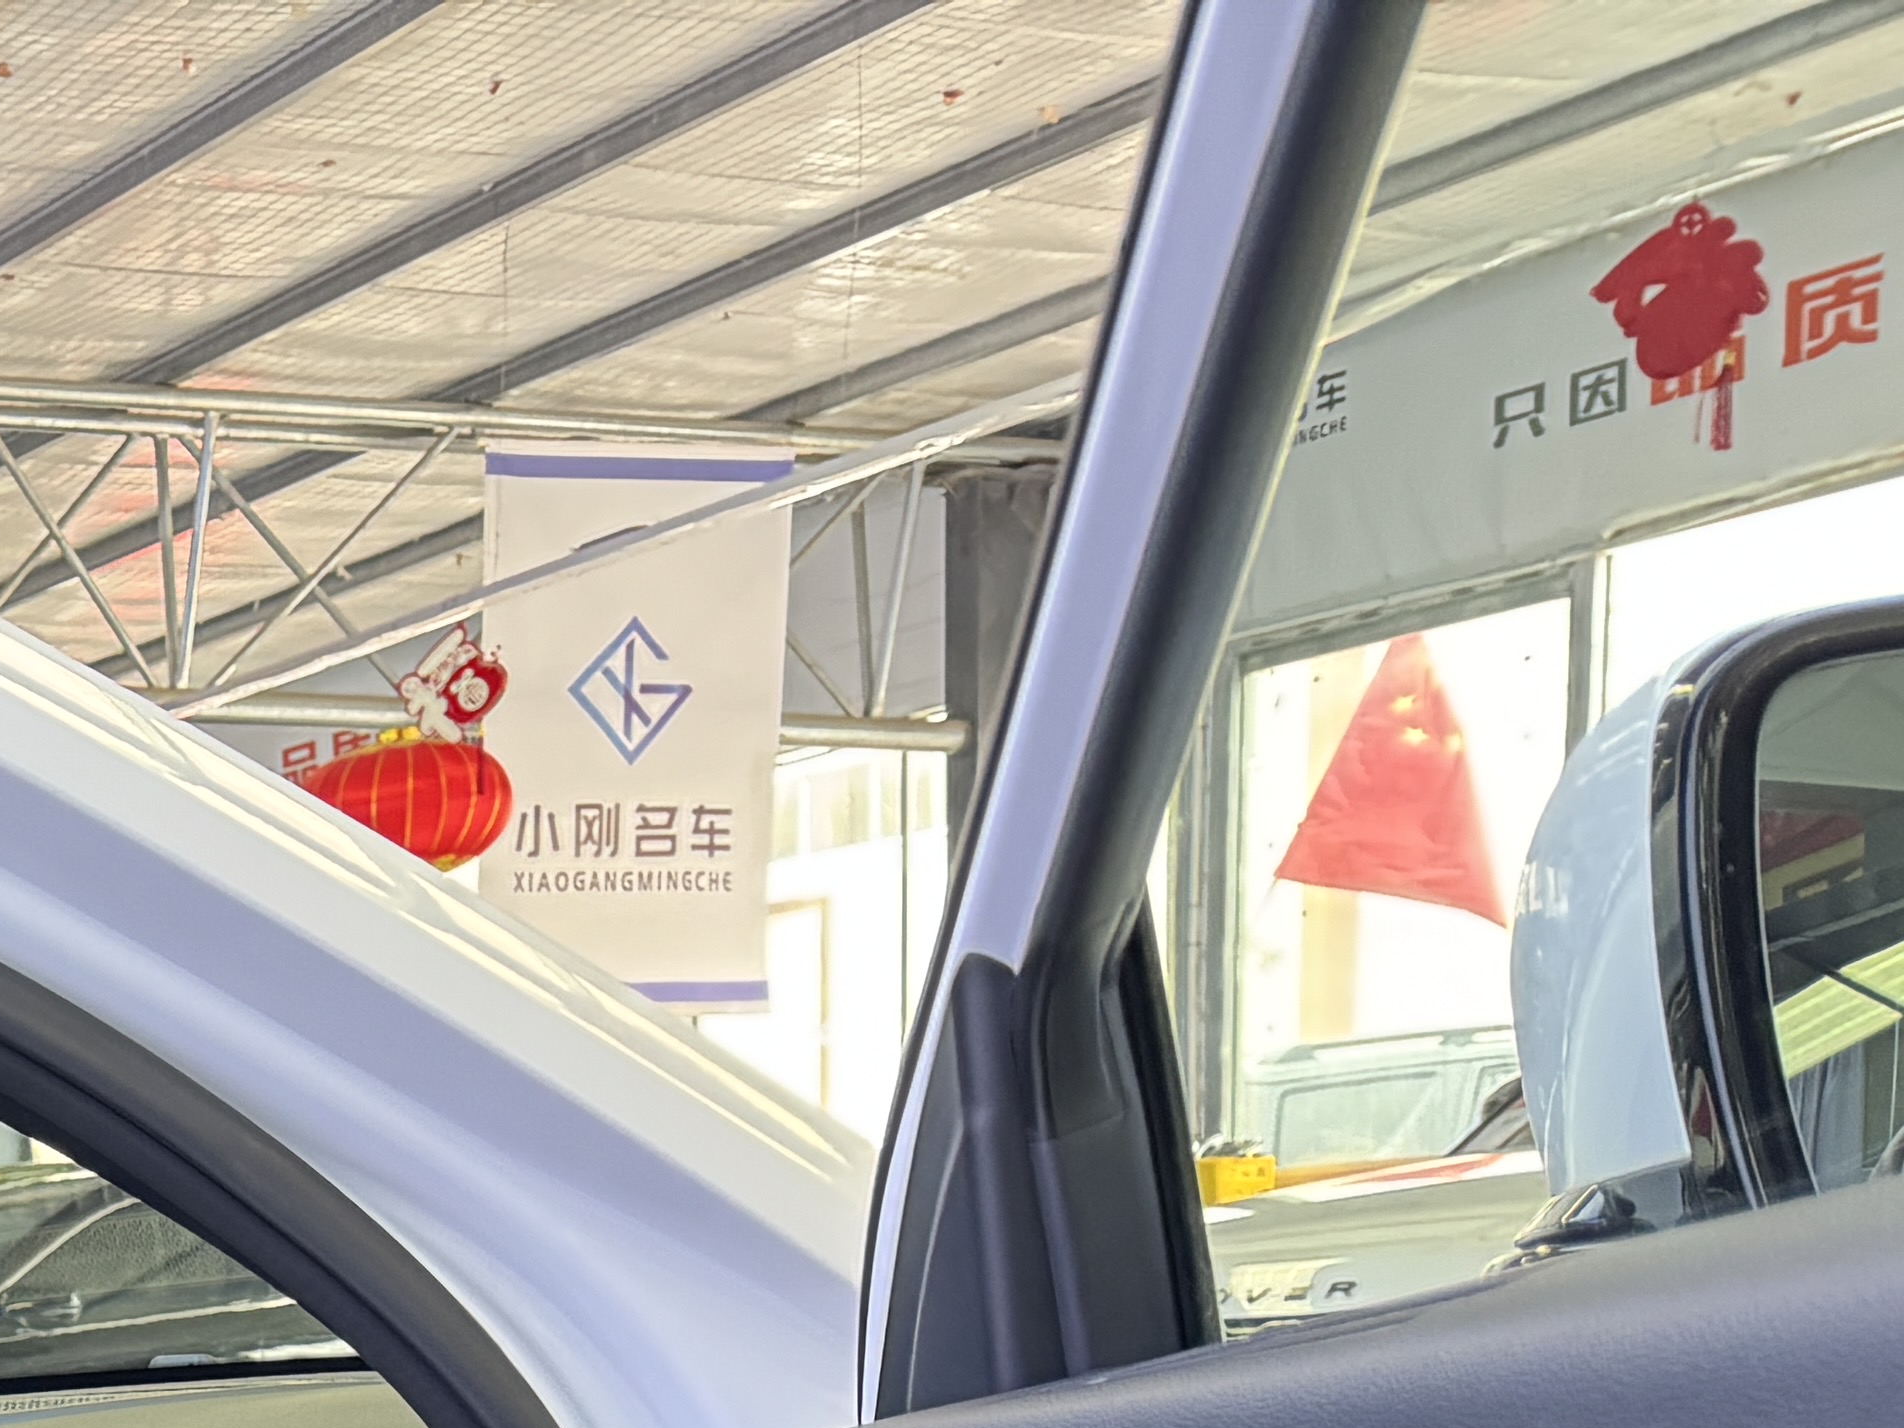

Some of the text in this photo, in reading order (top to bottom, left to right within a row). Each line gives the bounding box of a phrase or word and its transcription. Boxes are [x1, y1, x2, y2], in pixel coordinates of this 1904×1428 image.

[515, 803, 733, 858] 小刚名车
[514, 871, 733, 893] XIAOGANGMINGCHE
